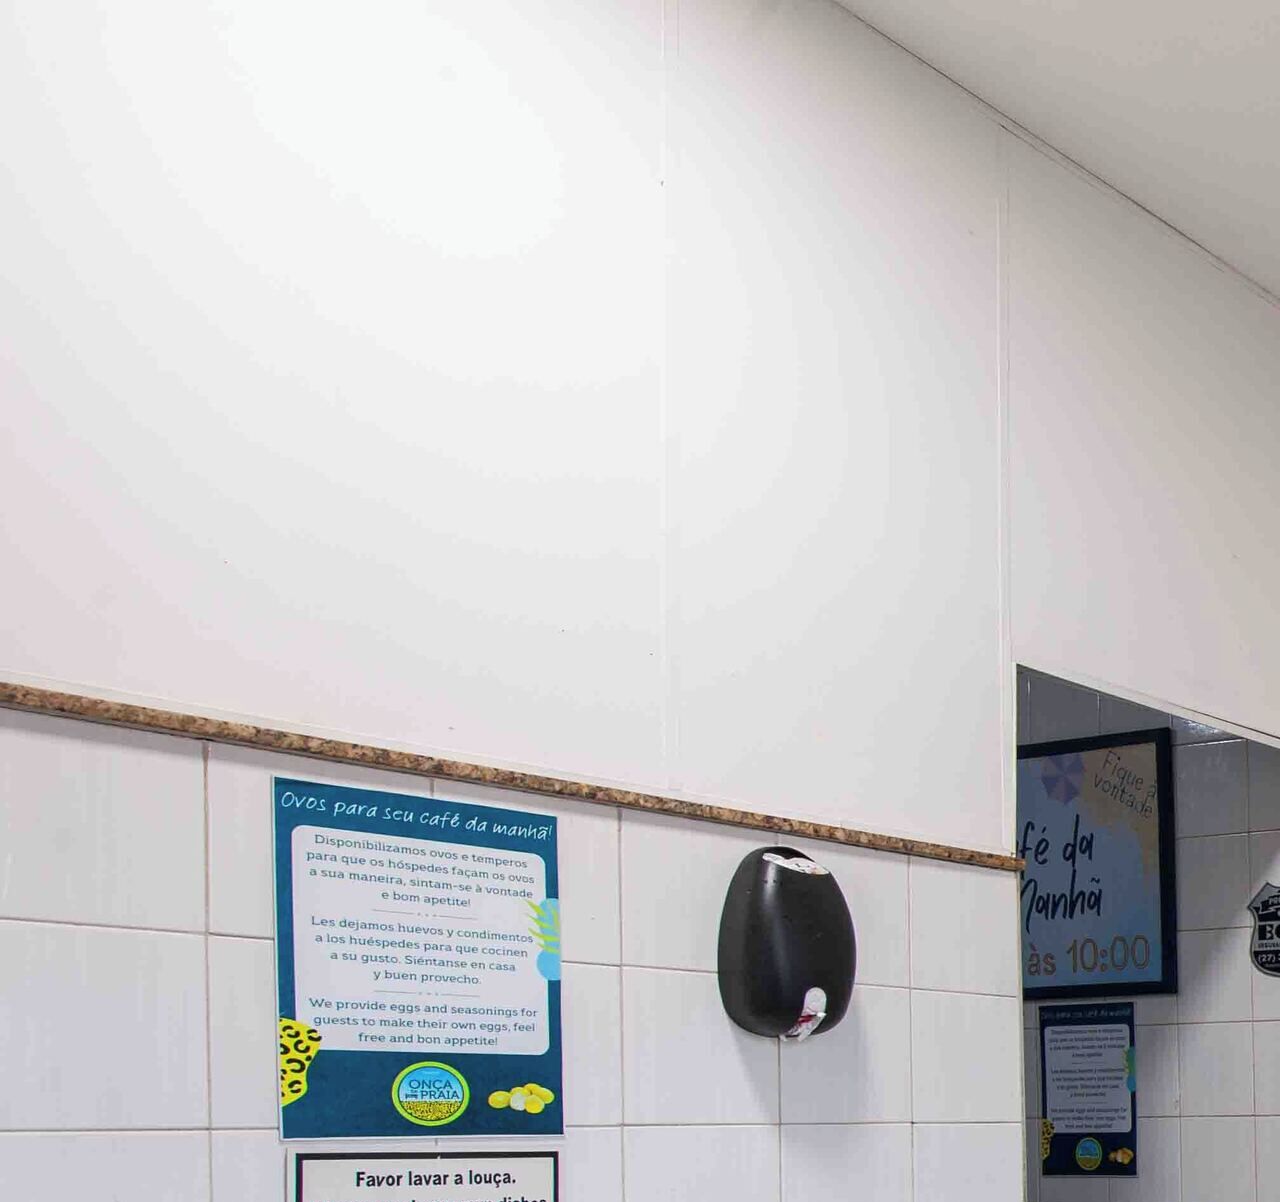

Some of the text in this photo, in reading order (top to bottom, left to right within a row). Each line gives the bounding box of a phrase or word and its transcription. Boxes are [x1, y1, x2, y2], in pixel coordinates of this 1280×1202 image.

[1103, 750, 1144, 791] Fique
[1094, 773, 1153, 819] vontade
[281, 791, 553, 841] Ovos para seu café da manhã!
[315, 834, 528, 868] Disponibilizamos ovos e temperos
[1062, 814, 1094, 869] da
[306, 851, 535, 884] para que os hóspedes façam os ovos
[309, 868, 317, 876] a
[320, 869, 345, 879] sua
[349, 872, 407, 887] maneira,
[409, 877, 472, 892] sintam-se
[485, 886, 533, 898] vontade
[381, 891, 471, 907] e bom apetite!
[311, 915, 534, 943] Les dejamos huevos y condimentos
[315, 933, 528, 958] a los huéspedes para que cocinen
[1027, 934, 1150, 976] às 10:00
[330, 952, 338, 960] a
[341, 952, 357, 961] su
[404, 955, 468, 969] Siéntanse
[470, 961, 486, 970] en
[488, 963, 516, 972] casa
[1258, 954, 1276, 964] (27)
[373, 969, 481, 985] y buen provecho.
[309, 998, 538, 1018] We provide eggs and seasonings for
[313, 1015, 536, 1033] guests to make their own eggs, feel
[358, 1032, 498, 1047] free and bon appetite!
[409, 1079, 453, 1091] ONÇA
[421, 1090, 460, 1100] PRAIA
[356, 1169, 516, 1188] Favor lavar a louça.
